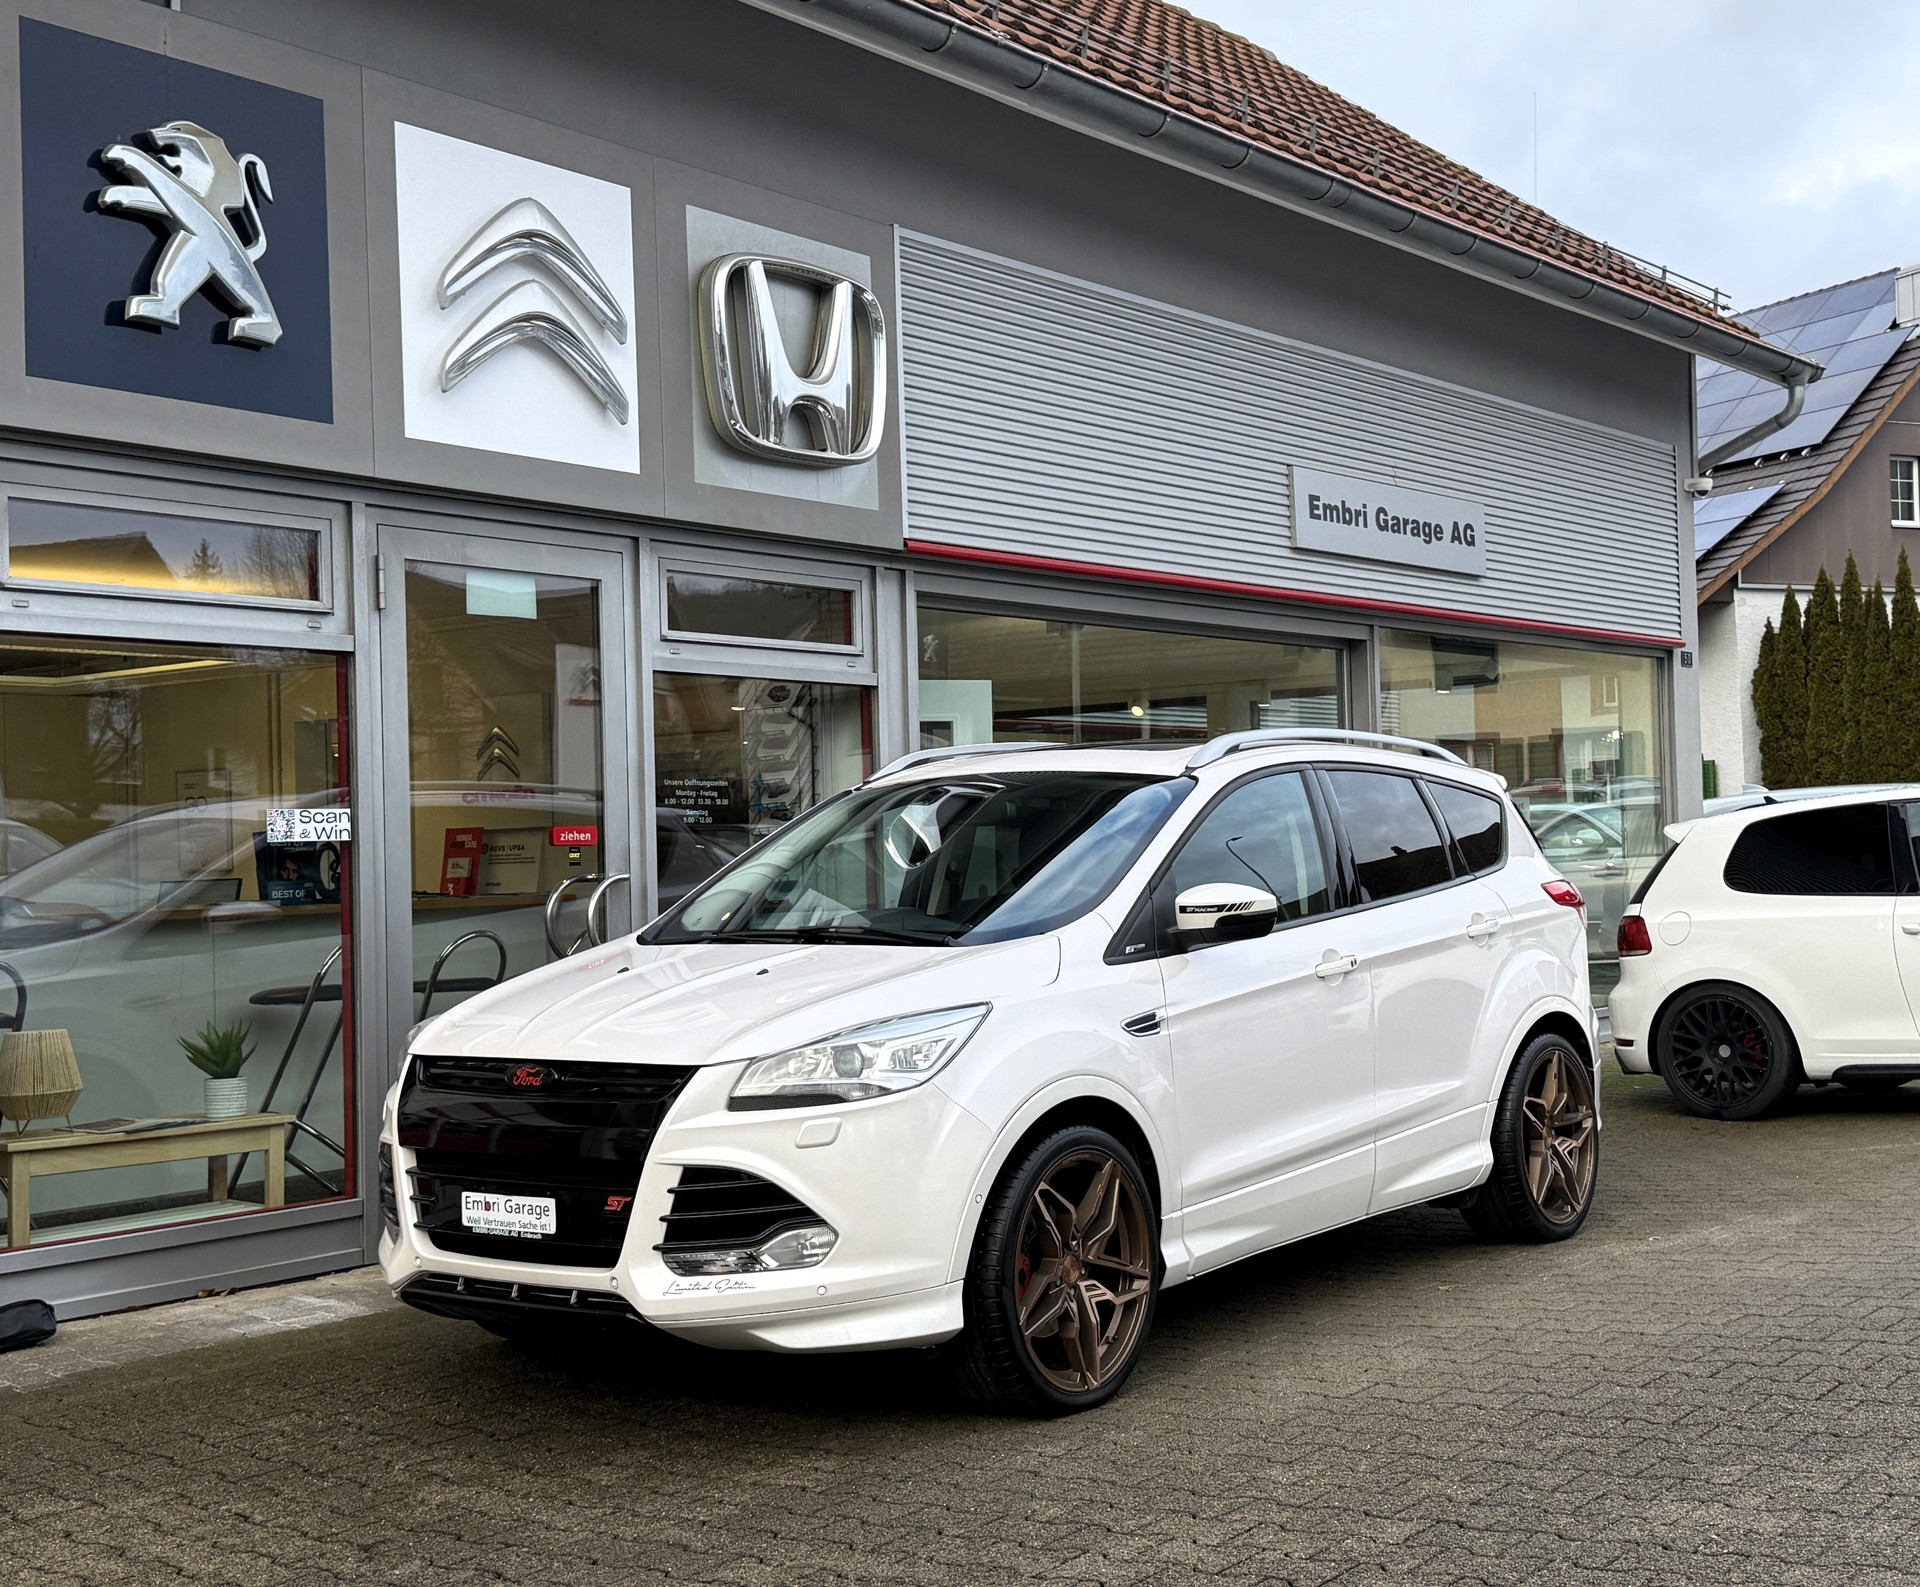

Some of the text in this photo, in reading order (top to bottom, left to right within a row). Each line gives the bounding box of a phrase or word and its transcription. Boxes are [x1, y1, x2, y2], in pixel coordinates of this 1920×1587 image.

[1308, 494, 1476, 547] Embri Garage AG
[676, 790, 696, 798] Montag
[700, 790, 718, 798] Freitag
[299, 810, 350, 824] Scan
[686, 808, 708, 816] Samstag
[299, 825, 351, 840] & Win
[560, 830, 592, 841] ziehen
[271, 890, 306, 899] BEST OF
[513, 1067, 544, 1086] Ford
[465, 1196, 550, 1220] Embri Garage
[604, 1196, 634, 1211] ST
[466, 1216, 481, 1225] Weil
[482, 1217, 516, 1228] Vertrauen
[518, 1220, 538, 1230] Sache
